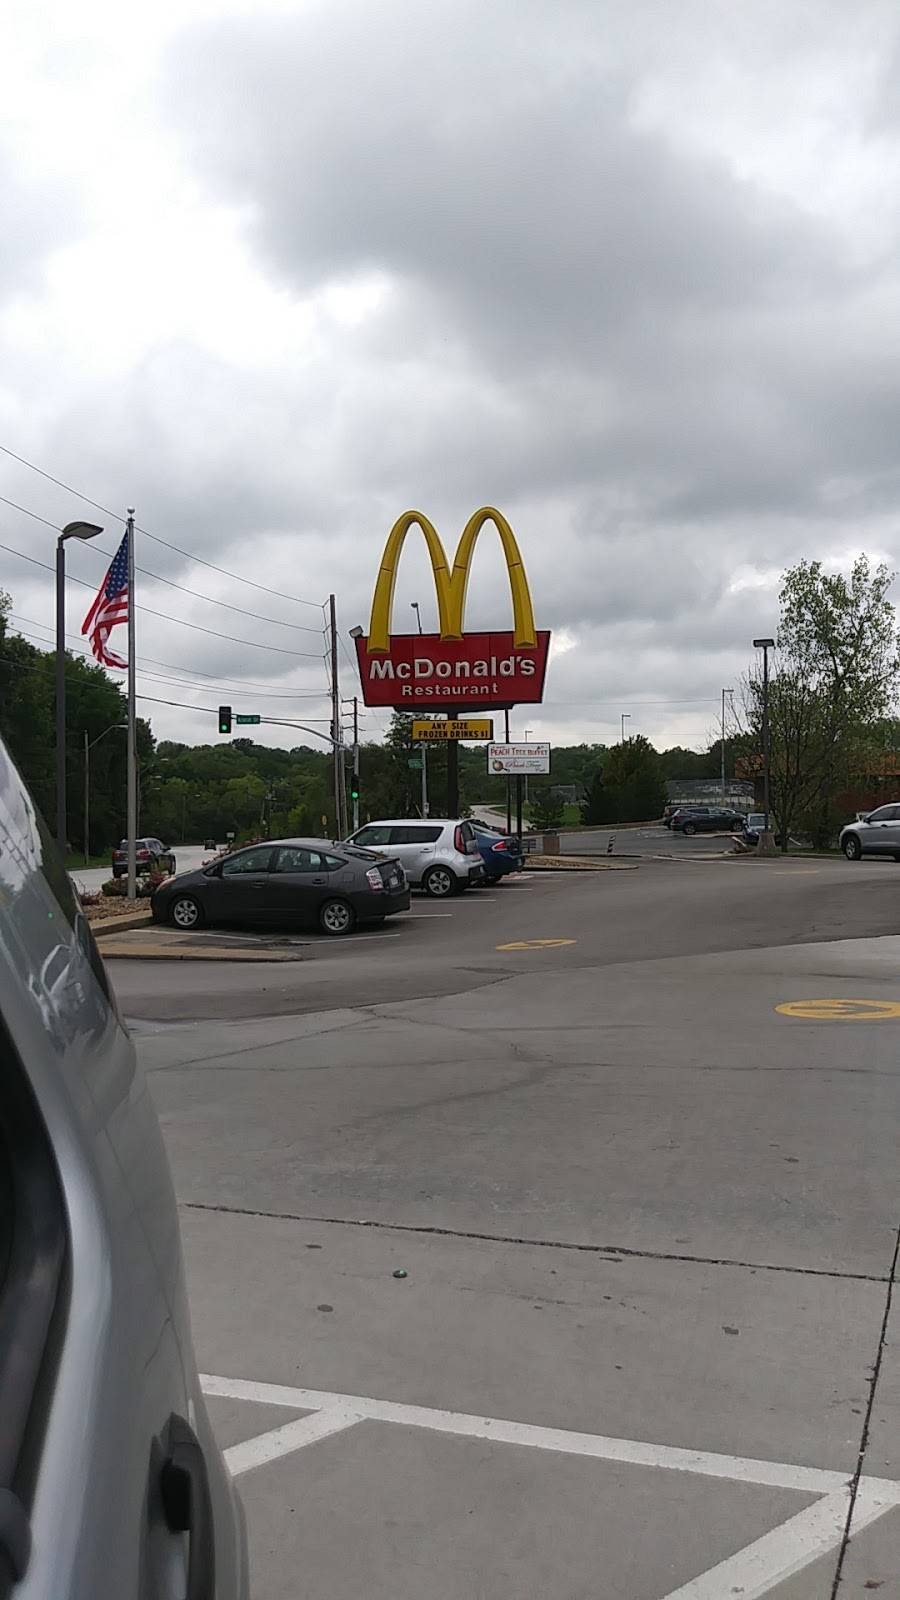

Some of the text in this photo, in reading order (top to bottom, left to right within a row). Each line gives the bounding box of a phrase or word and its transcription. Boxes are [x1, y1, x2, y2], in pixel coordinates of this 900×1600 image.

[369, 656, 536, 679] McDonald's
[402, 682, 499, 696] Restaurant
[431, 722, 469, 730] ANY SIZE
[418, 730, 448, 738] FROZEN
[450, 730, 479, 738] DRINKS
